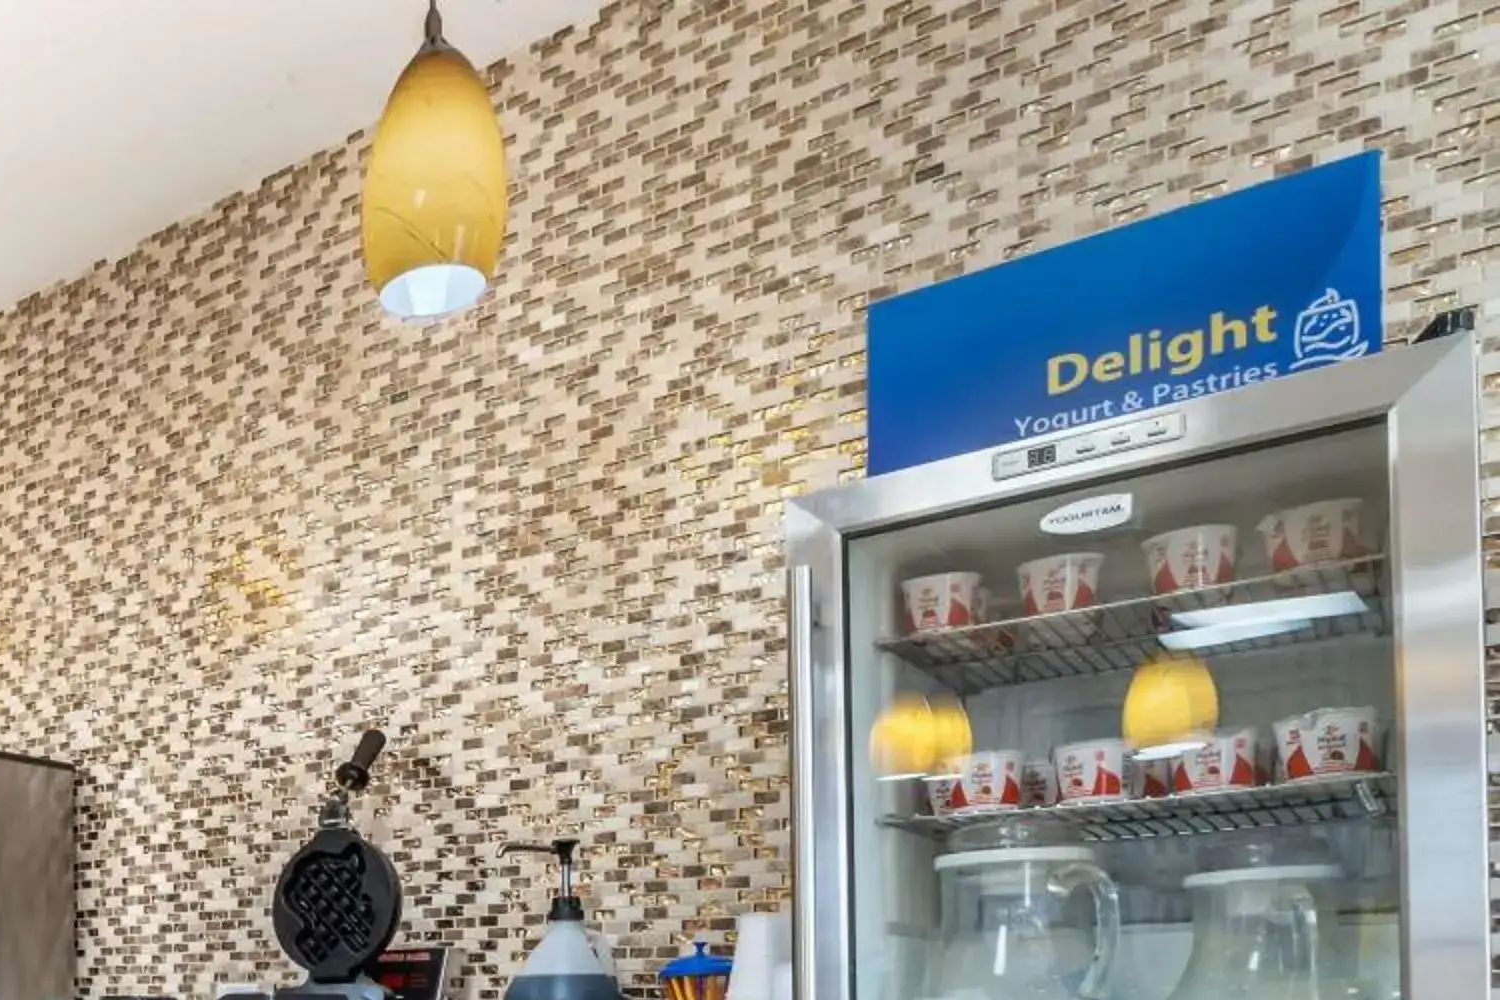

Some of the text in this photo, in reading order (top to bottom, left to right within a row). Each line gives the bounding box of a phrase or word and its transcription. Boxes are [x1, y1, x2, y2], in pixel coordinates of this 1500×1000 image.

[1046, 304, 1278, 396] Delight
[1014, 360, 1279, 437] Yogurt & Pastries
